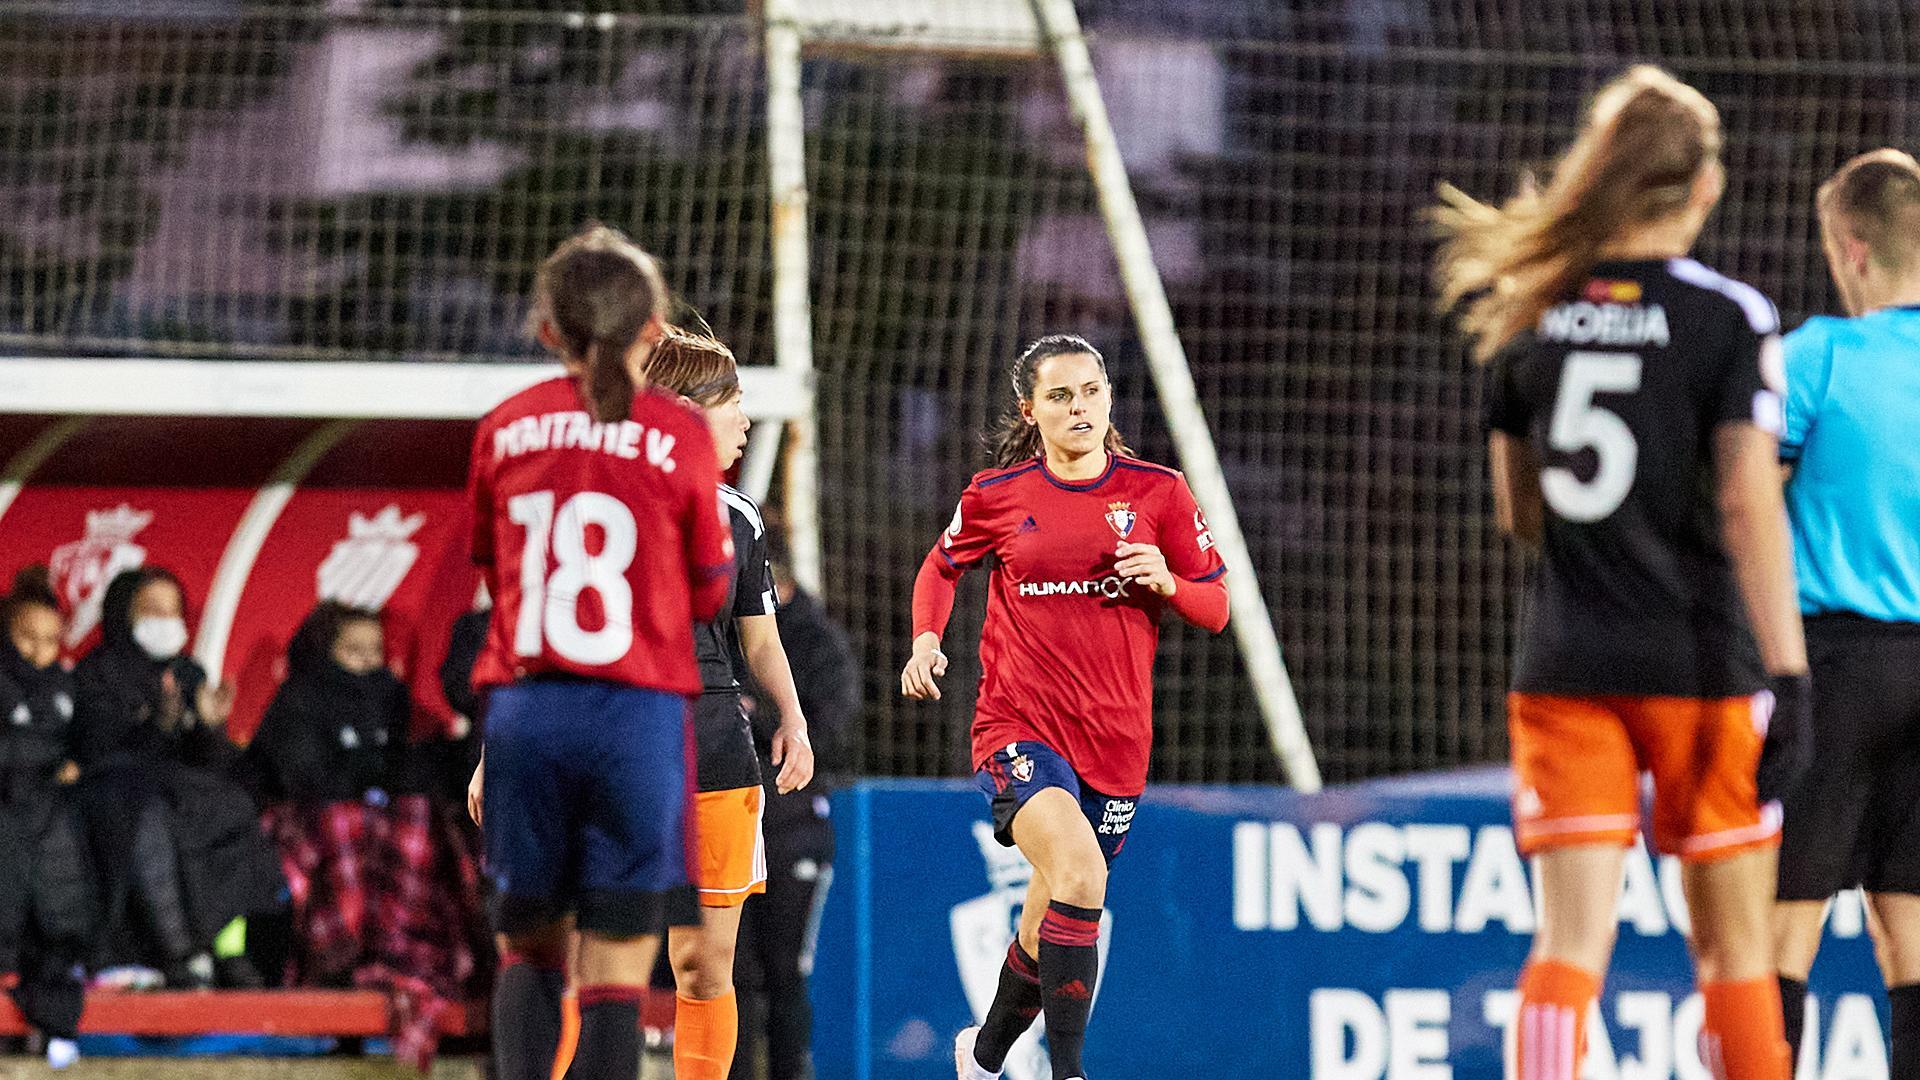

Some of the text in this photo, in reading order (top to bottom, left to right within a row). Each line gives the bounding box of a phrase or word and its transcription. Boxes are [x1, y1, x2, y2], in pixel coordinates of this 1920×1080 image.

[646, 427, 677, 473] V.
[1538, 350, 1643, 523] 5
[507, 489, 637, 665] 18
[1098, 822, 1112, 835] de
[1309, 988, 1453, 1080] DE
